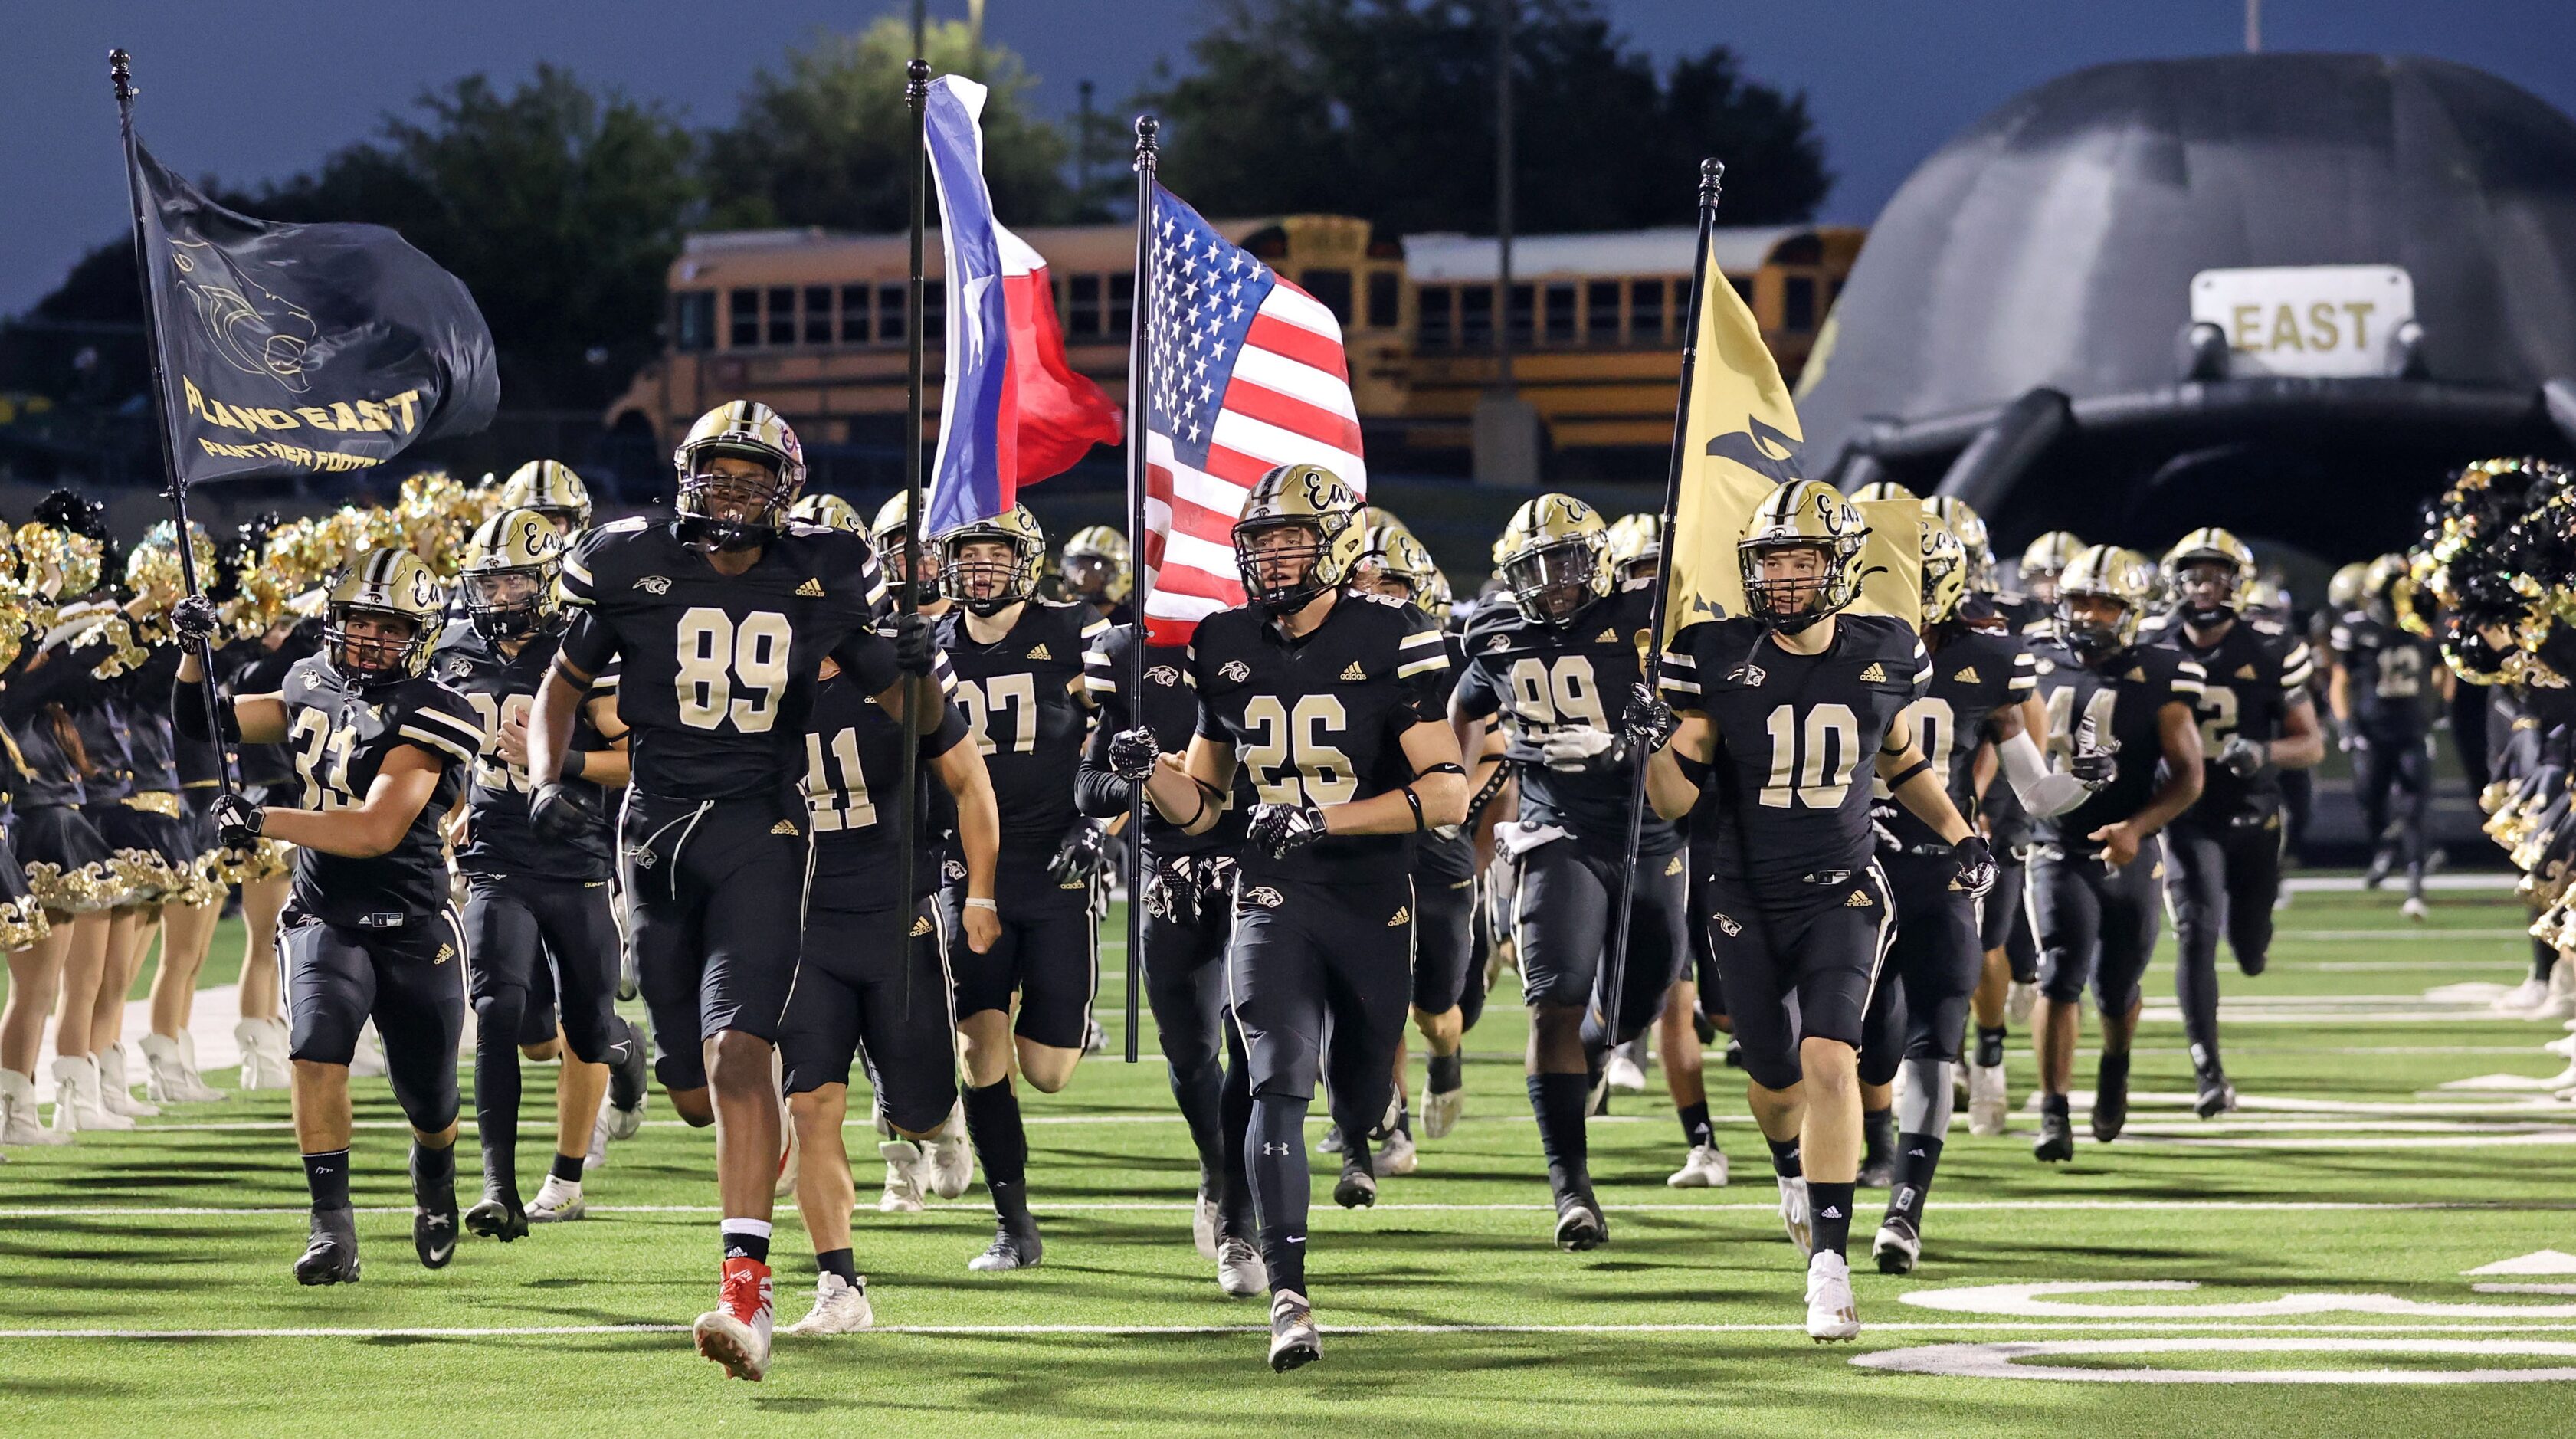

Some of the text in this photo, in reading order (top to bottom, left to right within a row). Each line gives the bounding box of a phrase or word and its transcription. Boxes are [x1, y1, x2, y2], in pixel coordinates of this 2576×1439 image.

[2233, 302, 2374, 352] EAST
[183, 374, 419, 435] PLANO EAST
[198, 438, 311, 467] PANTHER
[795, 588, 825, 597] adidas
[674, 606, 793, 733] 89
[1339, 672, 1367, 680] adidas
[1860, 674, 1886, 683] adidas
[1243, 693, 1359, 807] 26
[1758, 703, 1860, 808] 10
[770, 828, 799, 836] adidas
[909, 925, 934, 937] adidas
